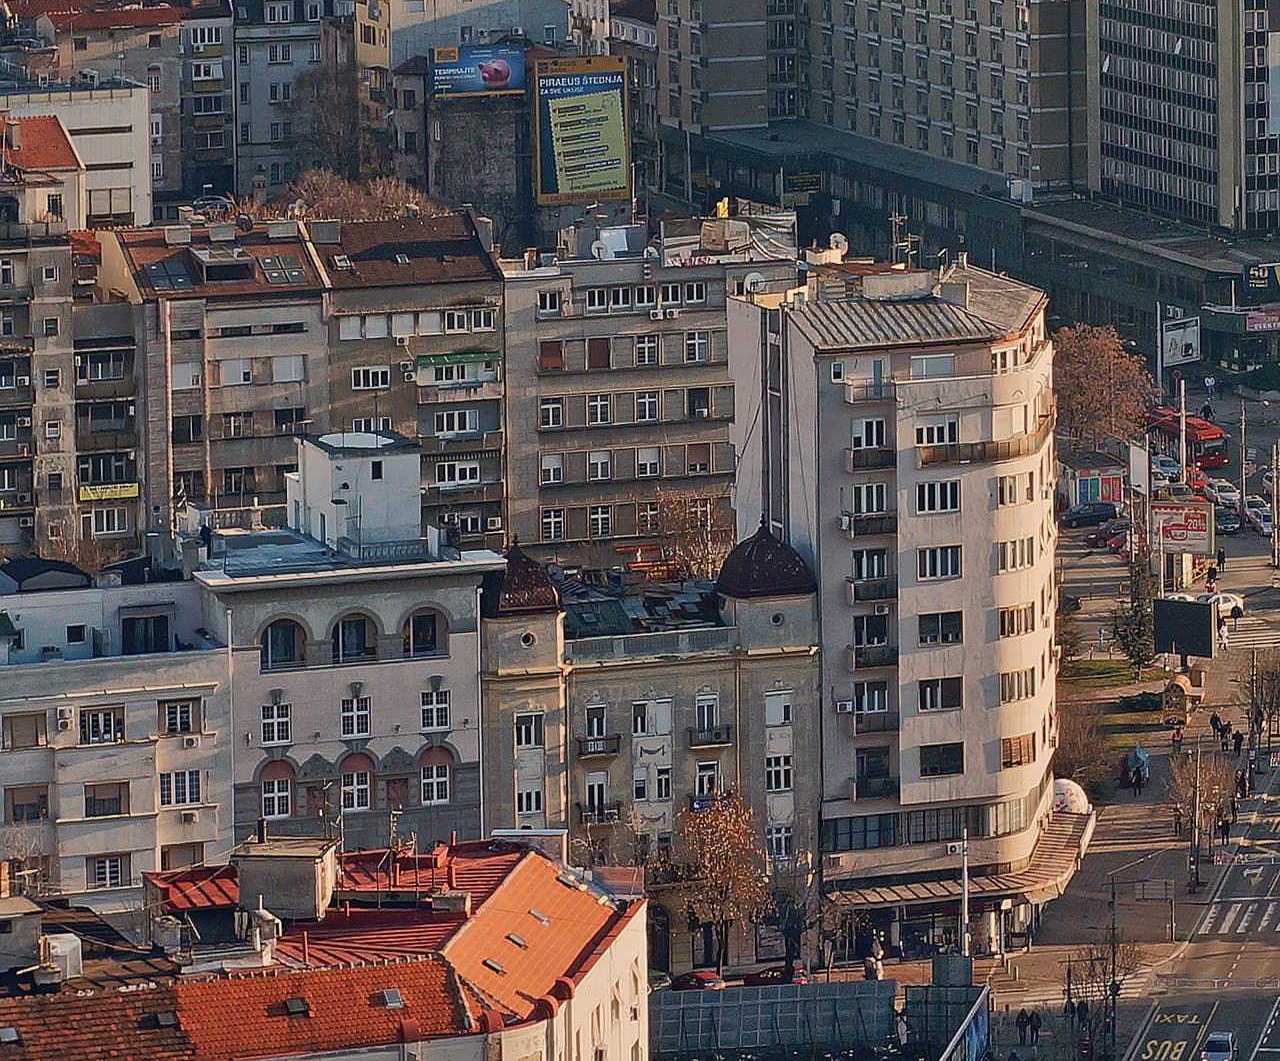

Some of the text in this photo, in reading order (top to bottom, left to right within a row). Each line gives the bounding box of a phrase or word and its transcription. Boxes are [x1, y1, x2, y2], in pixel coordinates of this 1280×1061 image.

[539, 75, 623, 87] PIRAEUS ŠTEDNJA
[1248, 266, 1269, 279] 50
[1155, 1013, 1201, 1025] TAXI
[1141, 1039, 1188, 1061] BUS
